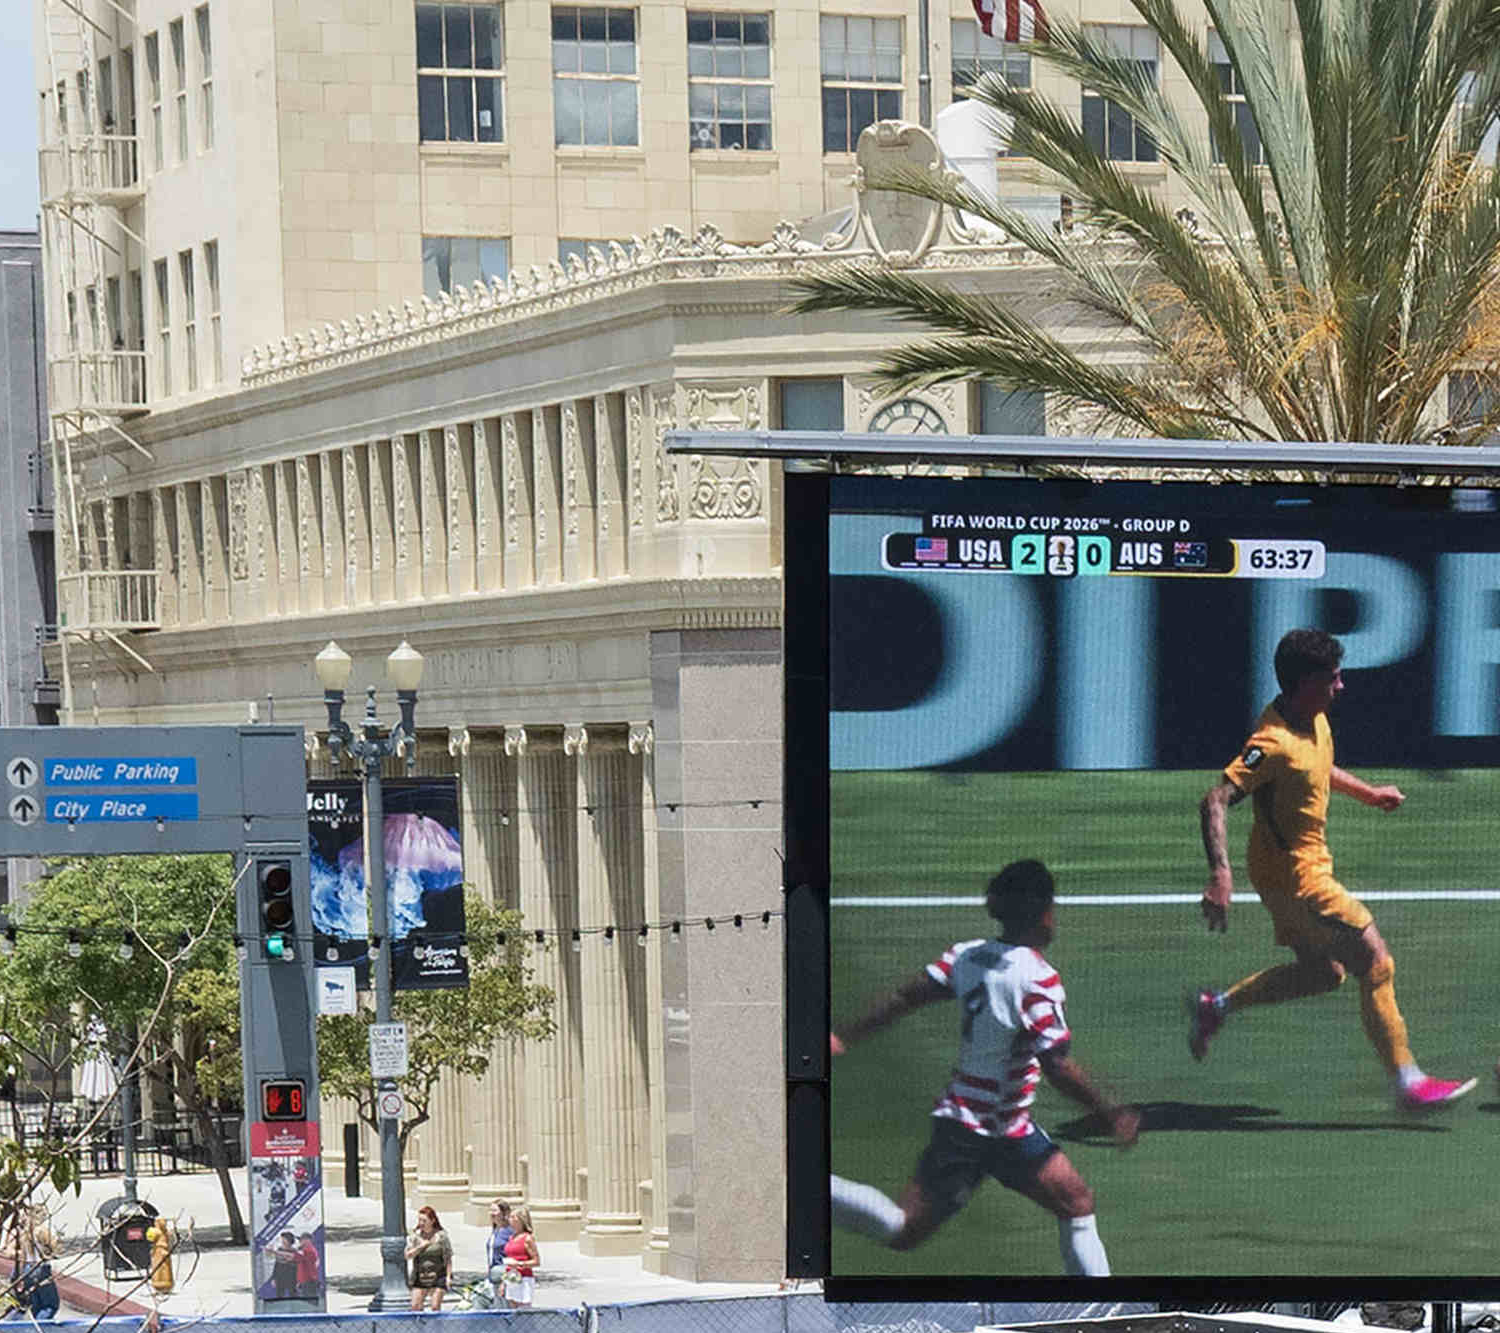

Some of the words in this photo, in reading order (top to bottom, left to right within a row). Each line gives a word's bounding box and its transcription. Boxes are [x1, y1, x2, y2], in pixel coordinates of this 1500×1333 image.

[931, 515, 966, 529] FIFA
[969, 516, 1030, 530] WORLD
[1032, 517, 1061, 531] CUP
[1122, 519, 1175, 533] GROUP
[1177, 520, 1190, 533] D
[958, 541, 1003, 563] USA
[1021, 544, 1039, 567] 2
[1086, 544, 1102, 567] 0
[1118, 545, 1163, 565] AUS
[1249, 548, 1311, 571] 63:37
[50, 763, 103, 782] Public
[113, 763, 179, 784] Parking
[52, 800, 92, 820] City
[102, 800, 147, 817] Place
